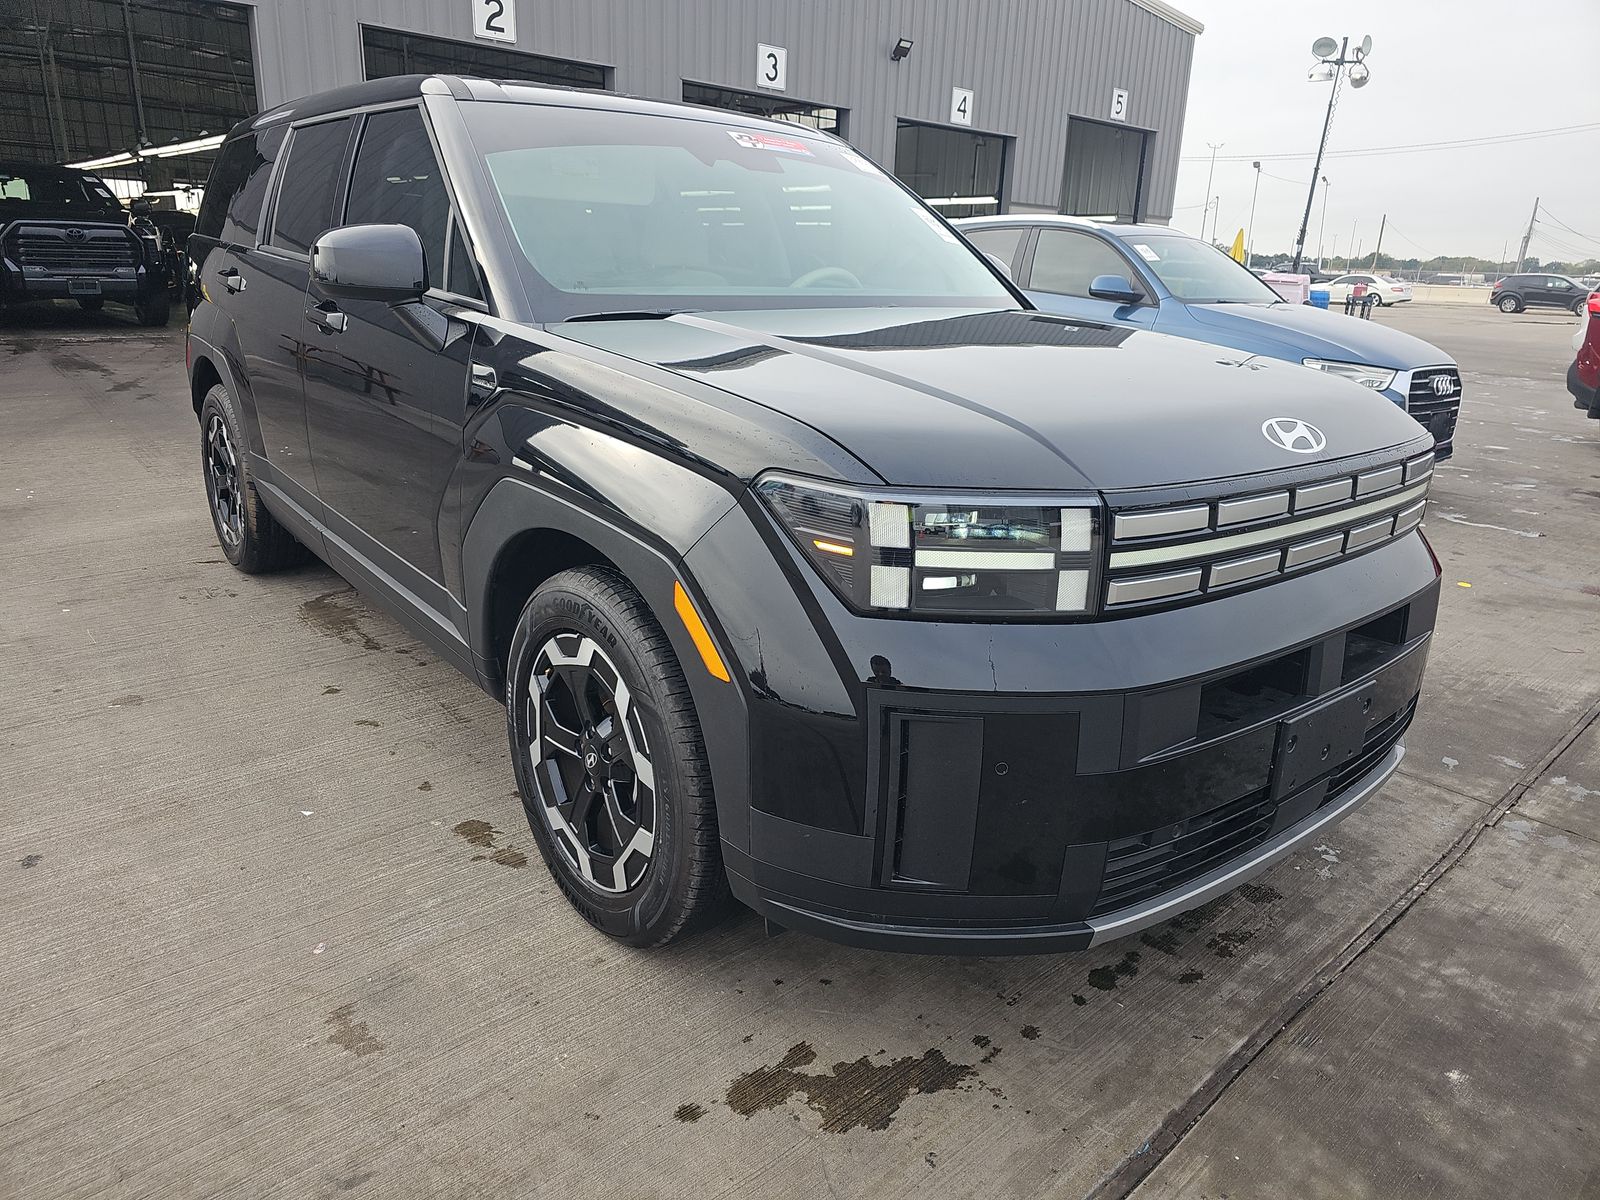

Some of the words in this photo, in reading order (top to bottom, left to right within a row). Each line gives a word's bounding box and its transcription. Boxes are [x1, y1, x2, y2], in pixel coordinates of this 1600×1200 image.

[485, 0, 505, 33] 2
[765, 52, 778, 82] 3
[957, 95, 967, 120] 4
[1115, 93, 1124, 115] 5
[552, 597, 618, 649] GOODYEAR
